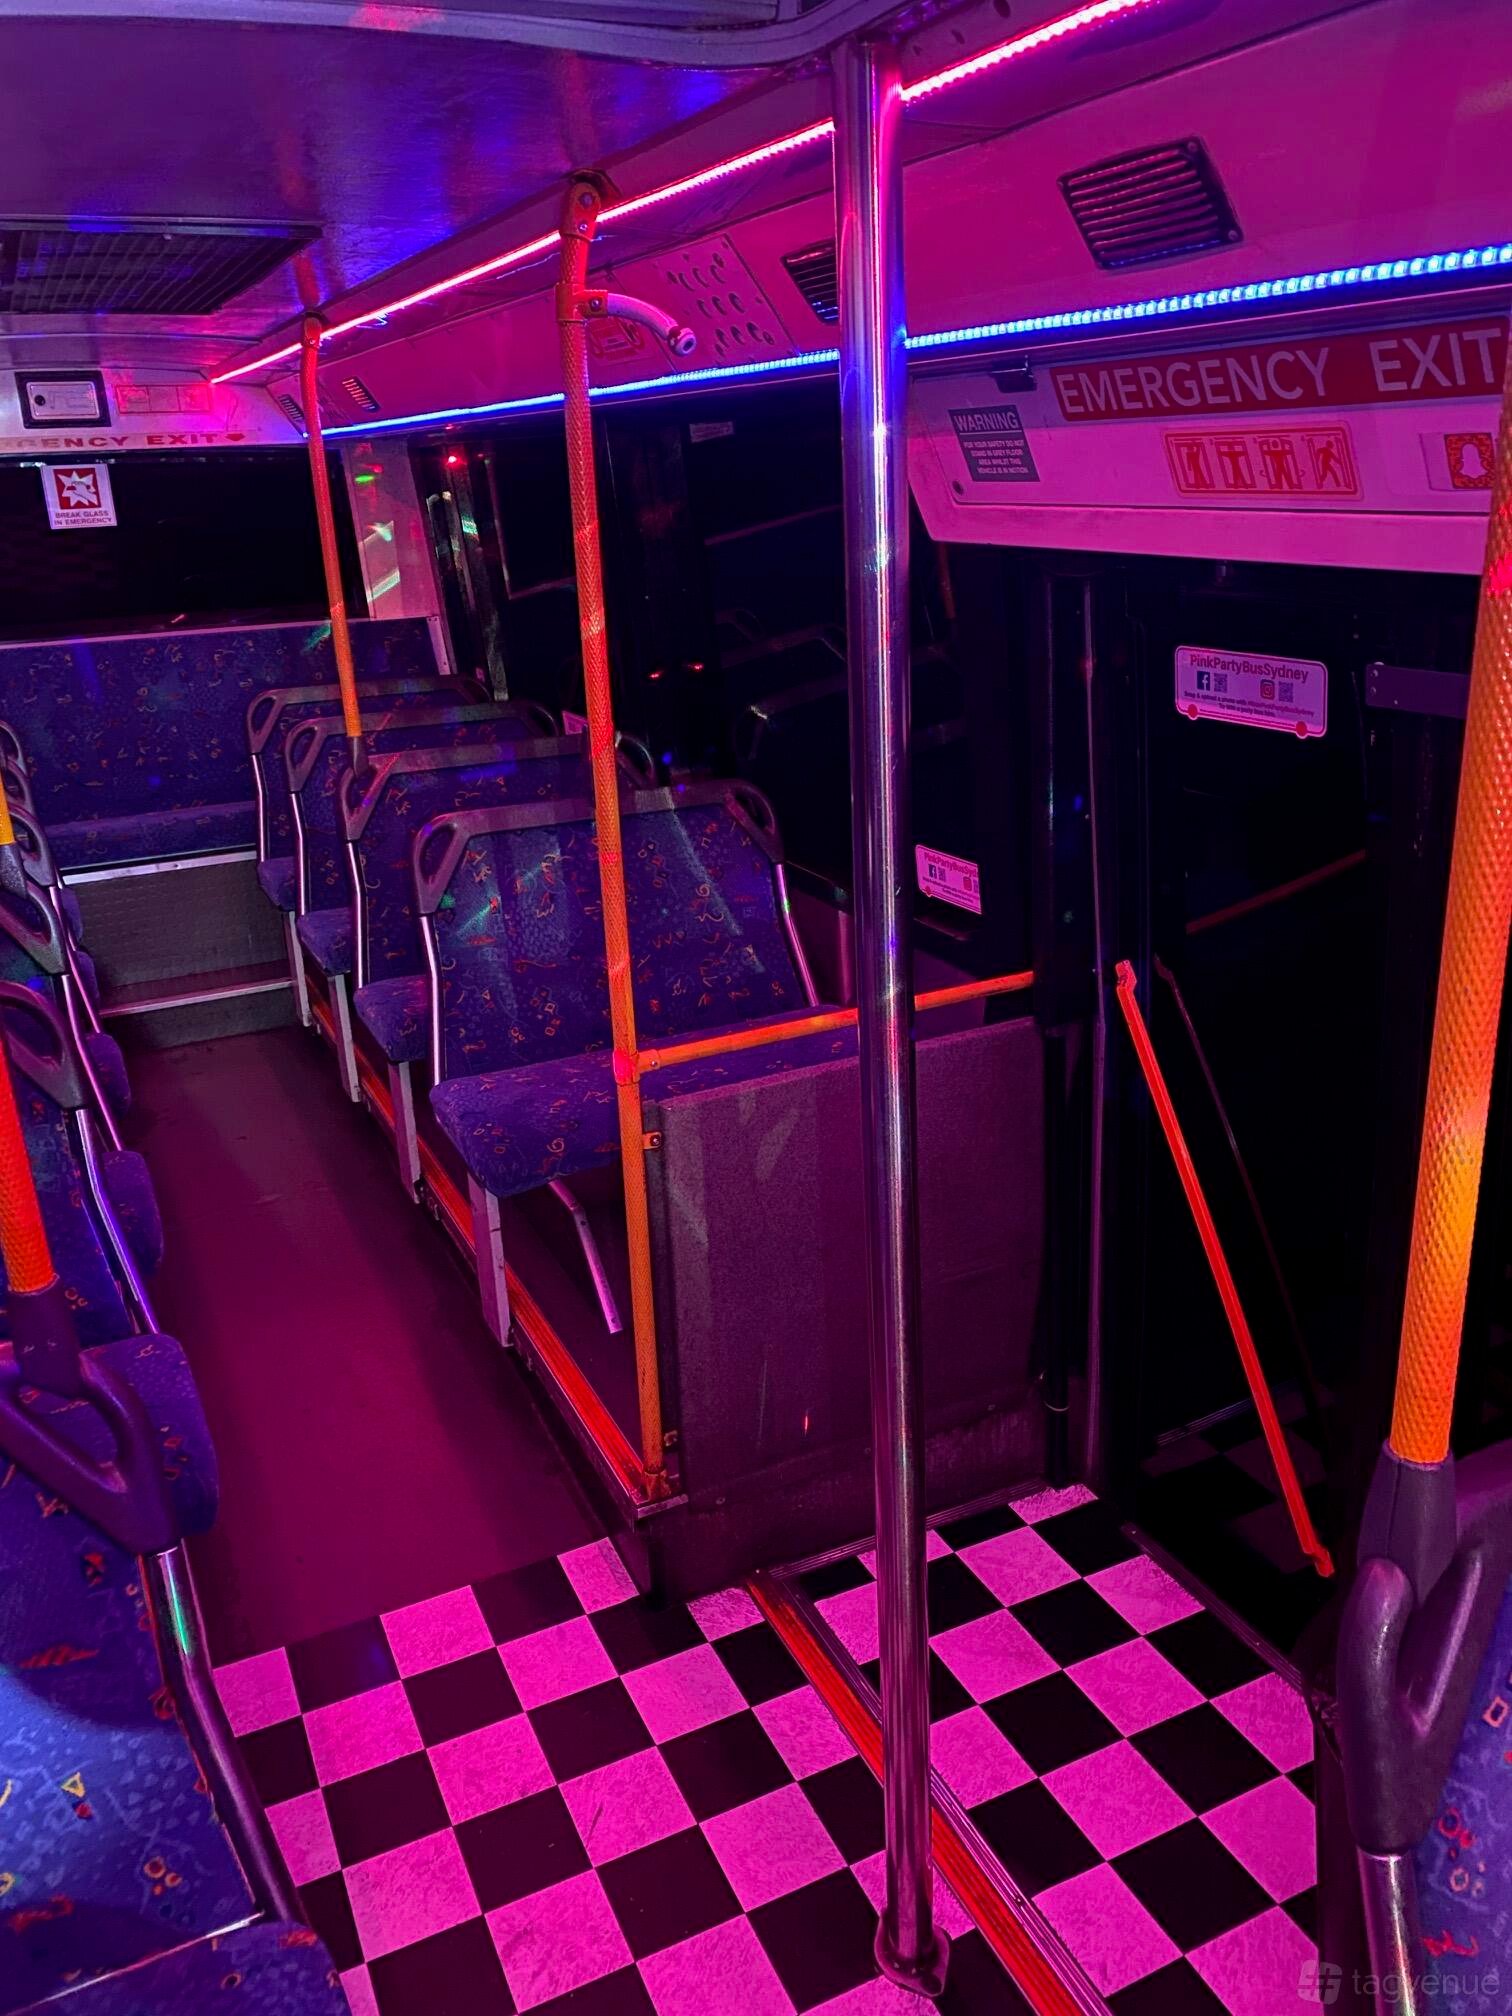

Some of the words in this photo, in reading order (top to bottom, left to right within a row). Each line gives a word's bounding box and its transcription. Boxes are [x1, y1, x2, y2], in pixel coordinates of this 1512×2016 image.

[1056, 346, 1330, 414] EMERGENCY
[1368, 327, 1502, 393] EXIT
[953, 411, 1019, 432] WARNING
[146, 433, 219, 446] EXIT
[55, 511, 81, 519] BREAK
[83, 510, 109, 518] GLASS
[65, 517, 112, 526] EMERGENCY
[1190, 653, 1309, 684] PinkPartyBusSydney
